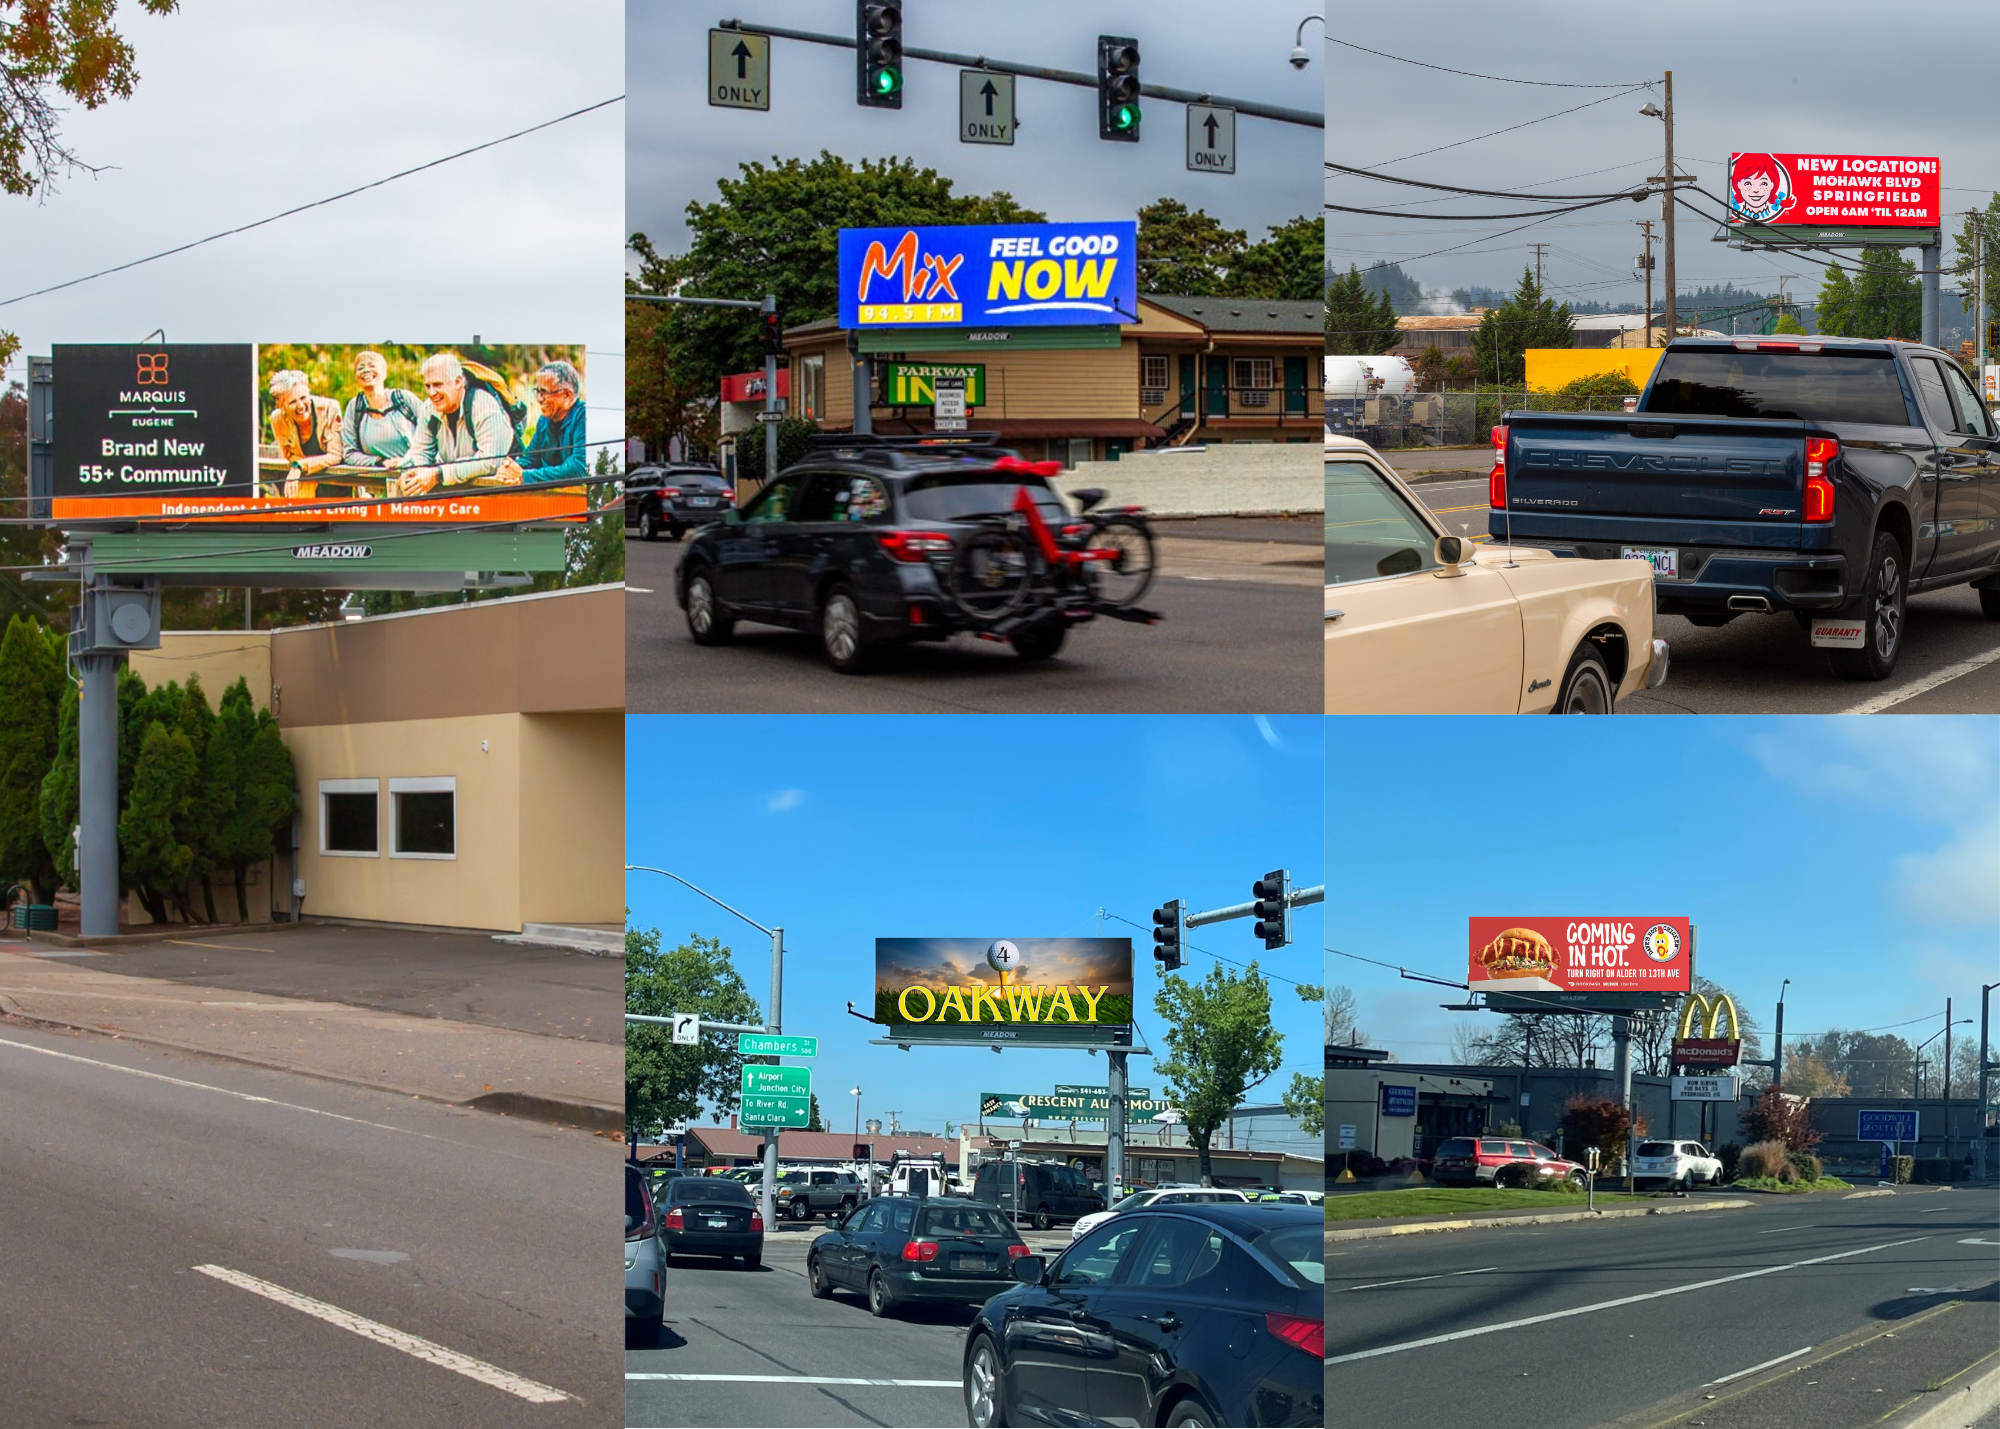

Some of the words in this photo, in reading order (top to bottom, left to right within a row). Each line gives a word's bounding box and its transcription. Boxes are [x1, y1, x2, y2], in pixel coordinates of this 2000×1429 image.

[718, 86, 761, 103] ONLY
[968, 123, 1007, 139] ONLY
[1195, 152, 1226, 167] ONLY
[1798, 158, 1838, 171] NEW
[1843, 160, 1937, 174] LOCATION!
[1813, 176, 1882, 187] MOHAWK
[1886, 177, 1921, 188] BLVD
[1813, 190, 1921, 202] SPRINGFIELD
[1806, 206, 1839, 216] OPEN
[1841, 207, 1868, 217] 6AM
[1894, 208, 1927, 217] 12AM
[990, 237, 1043, 257] FEEL
[1049, 235, 1119, 256] GOOD
[858, 230, 964, 302] Mix
[987, 258, 1118, 300] NOW
[864, 305, 914, 320] 94.5
[926, 305, 955, 319] FM
[969, 333, 1009, 341] MEADOW
[897, 366, 977, 377] PARKWAY
[120, 391, 186, 403] MARQUIS
[132, 419, 174, 427] EUGENE
[102, 439, 158, 456] Brand
[164, 439, 205, 456] New
[1527, 451, 1782, 474] CHEVROLET
[79, 466, 114, 483] 55+
[120, 465, 227, 487] Community
[1512, 498, 1579, 506] SILVERADO
[391, 503, 445, 517] Memory
[449, 503, 480, 515] Care
[296, 546, 367, 558] MEADOW
[1653, 555, 1675, 571] NCL
[1815, 627, 1862, 636] GUARANTY
[1567, 922, 1635, 944] COMING
[996, 946, 1010, 962] 4
[1569, 945, 1586, 967] IN
[1591, 945, 1629, 967] HOT.
[1567, 969, 1583, 978] TURN
[1586, 969, 1604, 978] RIGHT
[1606, 969, 1615, 978] ON
[1616, 969, 1636, 978] ALDER
[1639, 969, 1647, 978] TO
[1649, 969, 1665, 978] 13TH
[1667, 969, 1679, 978] AVE
[898, 985, 1109, 1022] OAKWAY
[744, 1039, 797, 1051] Chambers
[1677, 1048, 1733, 1056] McDonald's
[758, 1072, 783, 1082] Airport
[758, 1083, 788, 1092] Junction
[791, 1085, 806, 1095] City
[745, 1099, 753, 1107] To
[756, 1100, 774, 1108] River
[778, 1101, 789, 1109] Rd.
[745, 1114, 764, 1122] Santa
[767, 1114, 785, 1122] Clara
[1863, 1114, 1913, 1122] GOODWILL
